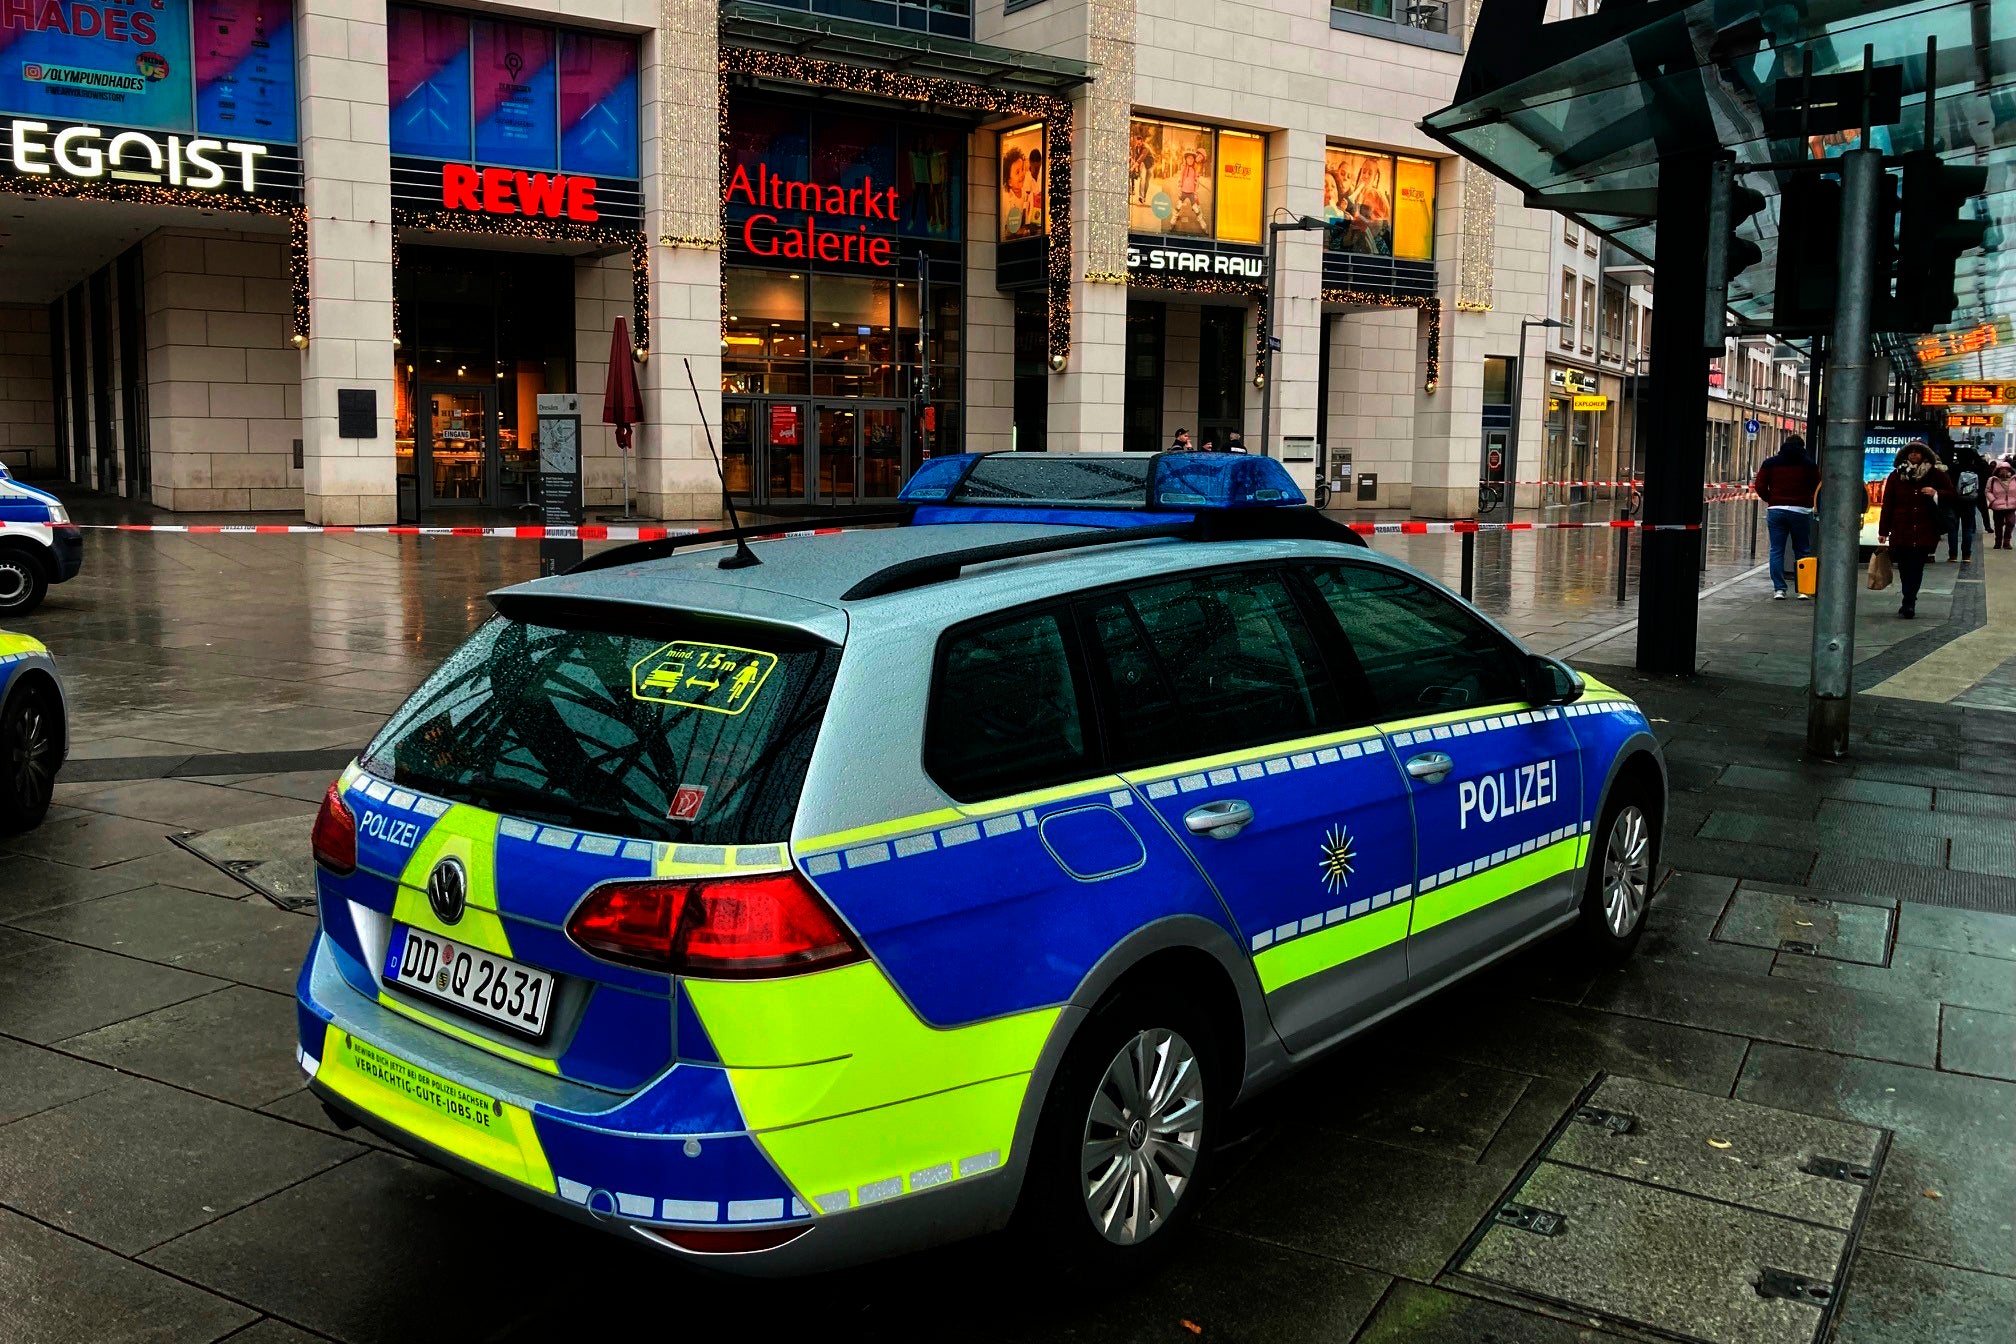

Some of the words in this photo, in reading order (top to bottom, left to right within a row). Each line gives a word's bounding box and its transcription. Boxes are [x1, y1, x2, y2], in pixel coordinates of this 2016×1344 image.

[3, 0, 157, 46] HADES
[12, 120, 268, 193] EGOIST
[442, 163, 599, 222] REWE
[725, 162, 900, 221] Altmarkt
[743, 213, 891, 266] Galerie
[1128, 248, 1210, 273] G-STAR
[1214, 255, 1263, 277] RAW
[444, 430, 470, 438] EINGANG
[666, 649, 693, 660] mind.
[1459, 759, 1557, 830] POLIZEI
[359, 810, 421, 849] POLIZEI
[401, 934, 440, 984] DD
[452, 952, 473, 998] Q
[473, 960, 544, 1026] 2631
[354, 1055, 490, 1127] VERDÄCHTIG-GUTE-JOBS.DE
[407, 1069, 417, 1080] BEI
[418, 1073, 430, 1086] DER
[431, 1080, 457, 1097] POLIZEI
[458, 1090, 489, 1111] SACHSEN
